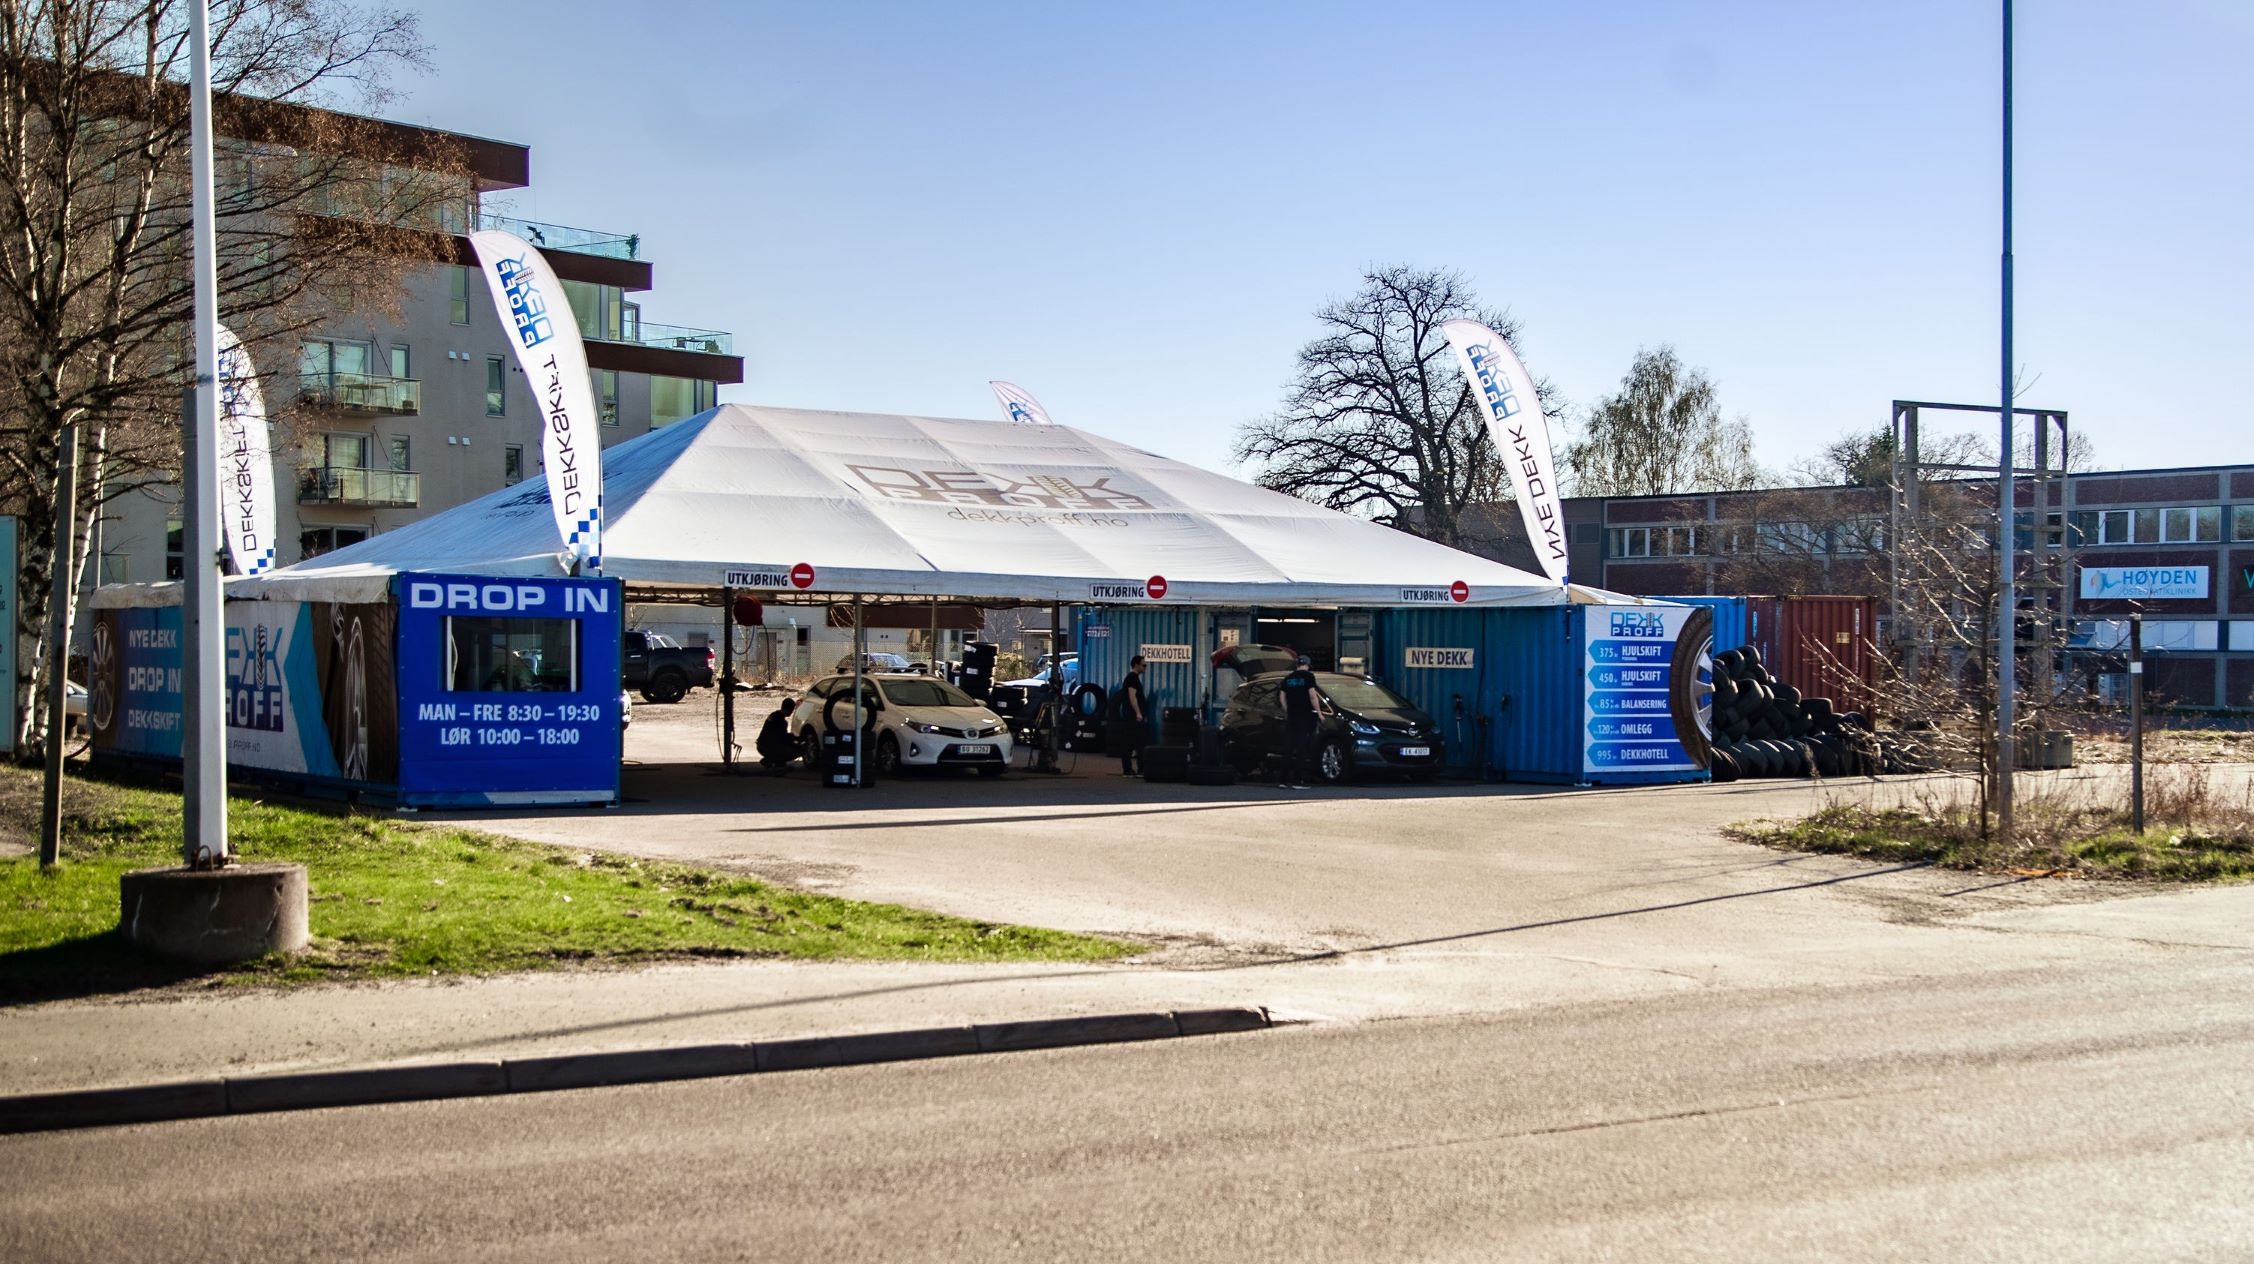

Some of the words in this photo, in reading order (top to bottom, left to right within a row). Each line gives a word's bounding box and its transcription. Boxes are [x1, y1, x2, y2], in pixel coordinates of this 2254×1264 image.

[947, 507, 1129, 527] dekkproff.no
[728, 572, 788, 587] UTKJØRING
[2123, 569, 2197, 585] HØYDEN
[411, 582, 546, 611] DROP
[565, 587, 608, 613] IN
[1093, 586, 1144, 598] UTKJØRING
[1403, 590, 1449, 601] UTKJØRING
[2123, 587, 2197, 596] OSTEOATIKLINIKK
[1612, 626, 1663, 636] PROFF
[129, 629, 149, 648] NYE
[1141, 647, 1191, 660] DEKKHOTELL
[1411, 650, 1434, 665] NYE
[1437, 650, 1468, 666] DEKK
[1600, 647, 1614, 658] 375
[1621, 645, 1662, 657] HJULSKIFT
[128, 667, 164, 692] DROP
[168, 668, 182, 694] IN
[1600, 672, 1614, 683] 450
[1621, 670, 1662, 682] HJULSKIFT
[1600, 698, 1610, 709] 85
[1621, 699, 1667, 709] BALANSERING
[418, 704, 456, 721] MAN
[473, 704, 503, 721] FRE
[507, 705, 542, 721] 8:30
[559, 705, 600, 721] 19:30
[128, 709, 181, 731] DEKKSKIFT
[441, 727, 471, 745] LØR
[477, 728, 521, 745] 10:00
[538, 728, 580, 745] 18:00
[1598, 724, 1610, 735] 120
[1621, 723, 1652, 734] OMLEGG
[1597, 750, 1611, 760] 995
[1621, 748, 1669, 760] DEKKHOTELL
